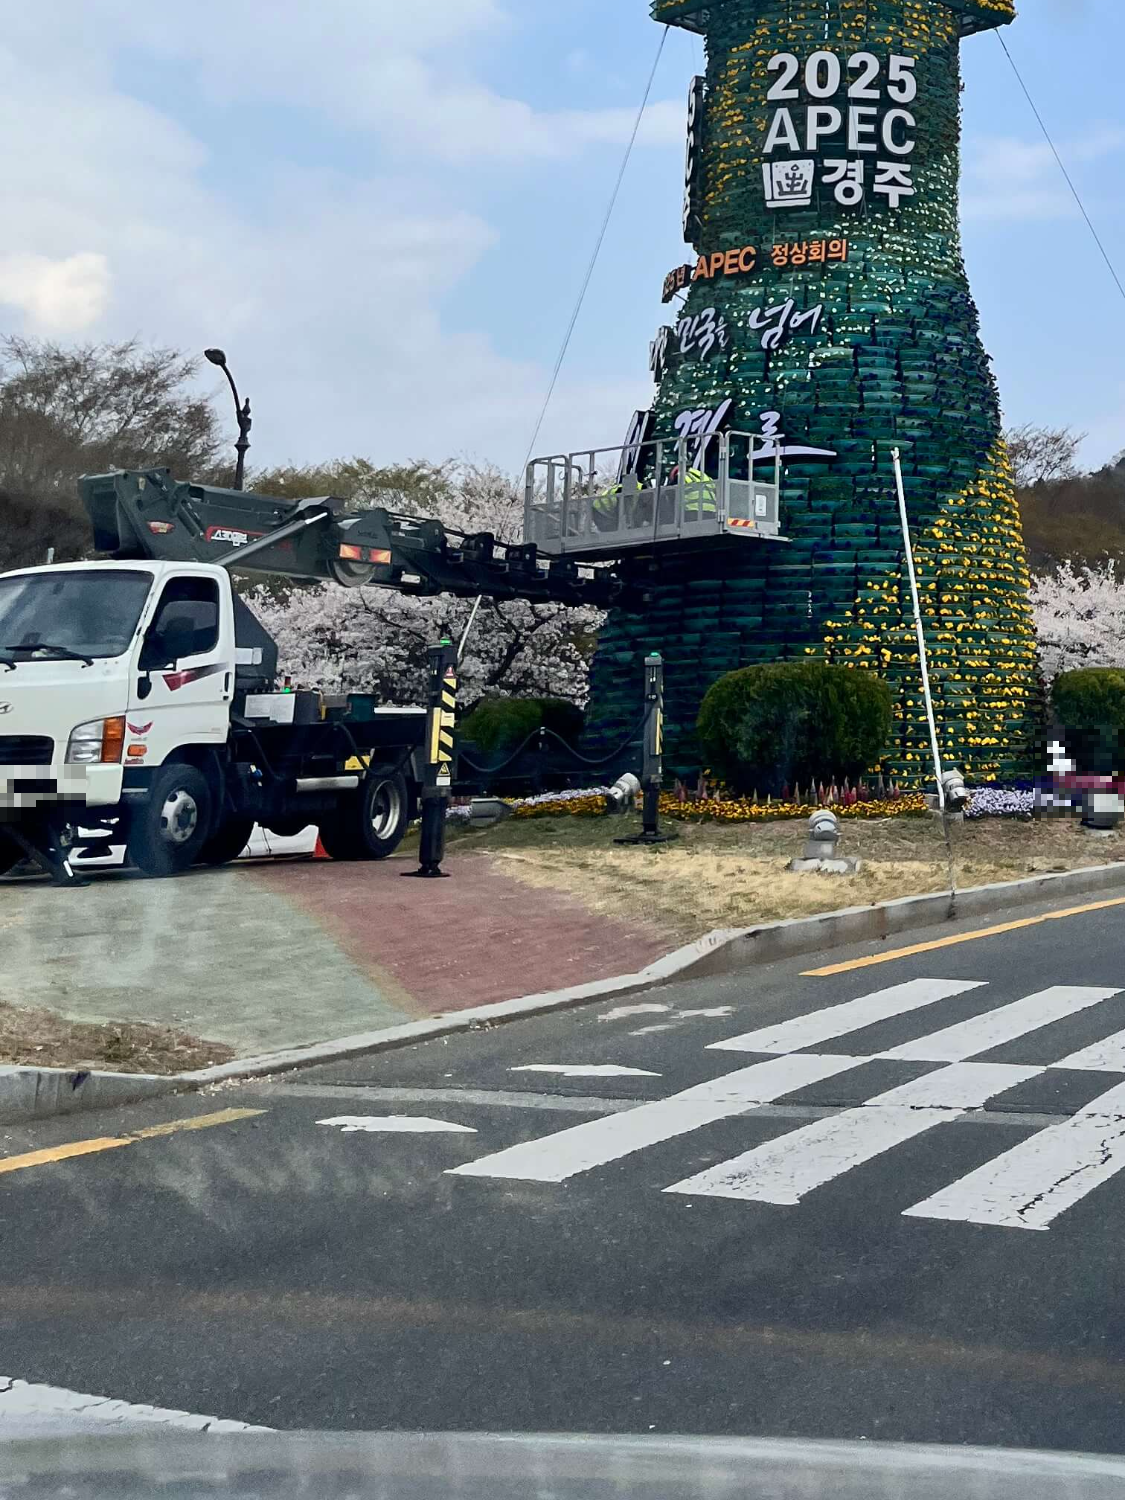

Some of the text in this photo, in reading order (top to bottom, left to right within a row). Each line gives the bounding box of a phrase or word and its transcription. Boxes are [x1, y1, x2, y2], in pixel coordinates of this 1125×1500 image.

[766, 50, 917, 104] 2025
[762, 104, 916, 155] APEC
[821, 158, 915, 209] 경주
[691, 245, 757, 282] APEC
[770, 238, 847, 267] 정상회의
[749, 297, 823, 350] 넘어
